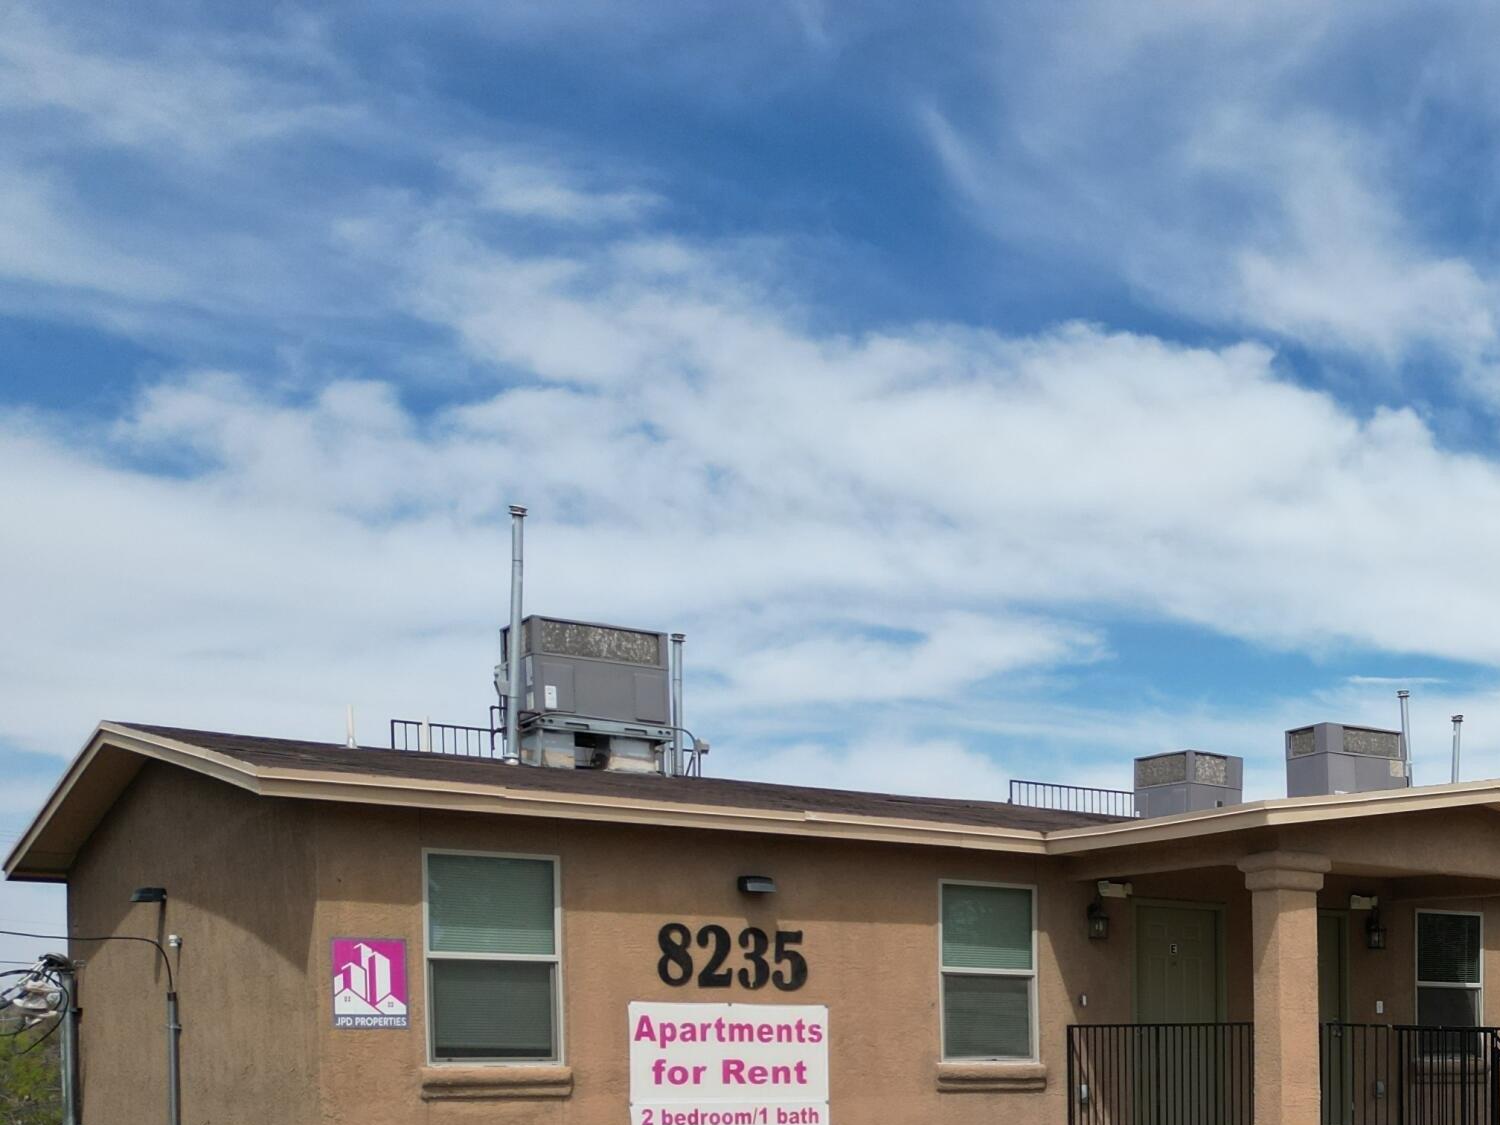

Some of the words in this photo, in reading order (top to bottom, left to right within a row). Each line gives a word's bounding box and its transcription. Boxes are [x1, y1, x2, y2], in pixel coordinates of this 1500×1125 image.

[657, 922, 808, 991] 8235
[336, 1017, 352, 1026] JPD
[355, 1017, 407, 1026] PROPERTIES
[634, 1015, 823, 1048] Apartments
[652, 1059, 707, 1085] for
[722, 1059, 807, 1084] Rent
[661, 1107, 768, 1125] bedroom/1
[777, 1107, 819, 1124] bath
